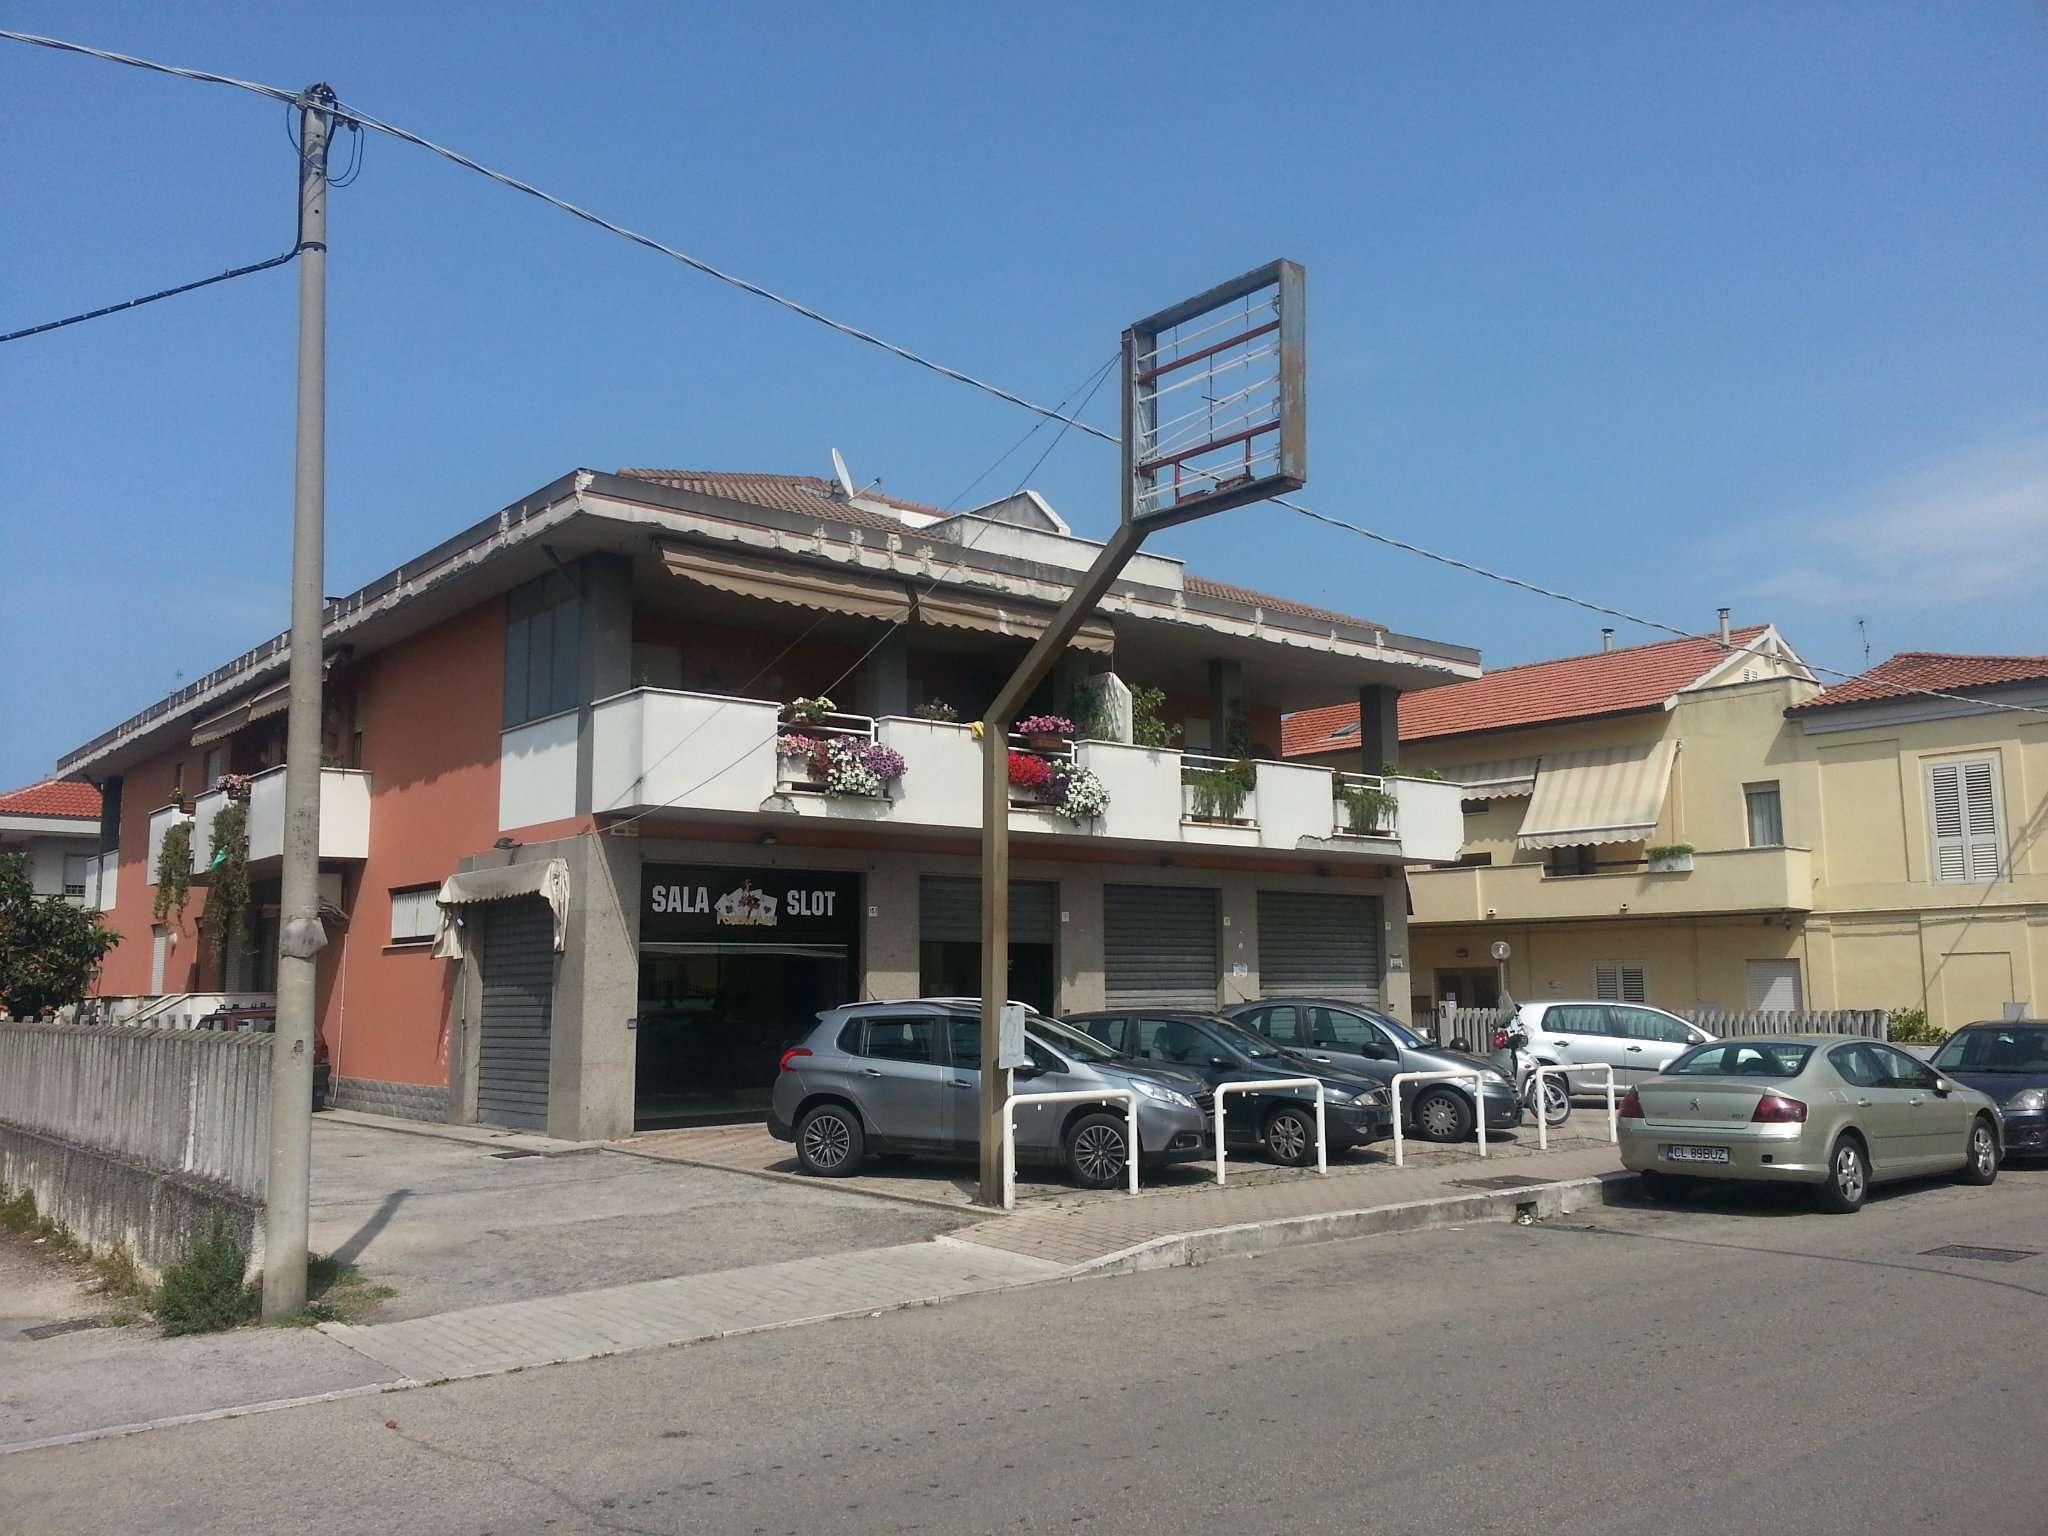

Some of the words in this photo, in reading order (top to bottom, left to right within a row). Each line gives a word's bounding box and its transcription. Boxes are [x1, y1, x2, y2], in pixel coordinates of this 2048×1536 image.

[652, 885, 710, 913] SALA
[787, 889, 836, 916] SLOT
[1674, 1147, 1687, 1158] CL
[1690, 1147, 1726, 1160] 89BUZ
